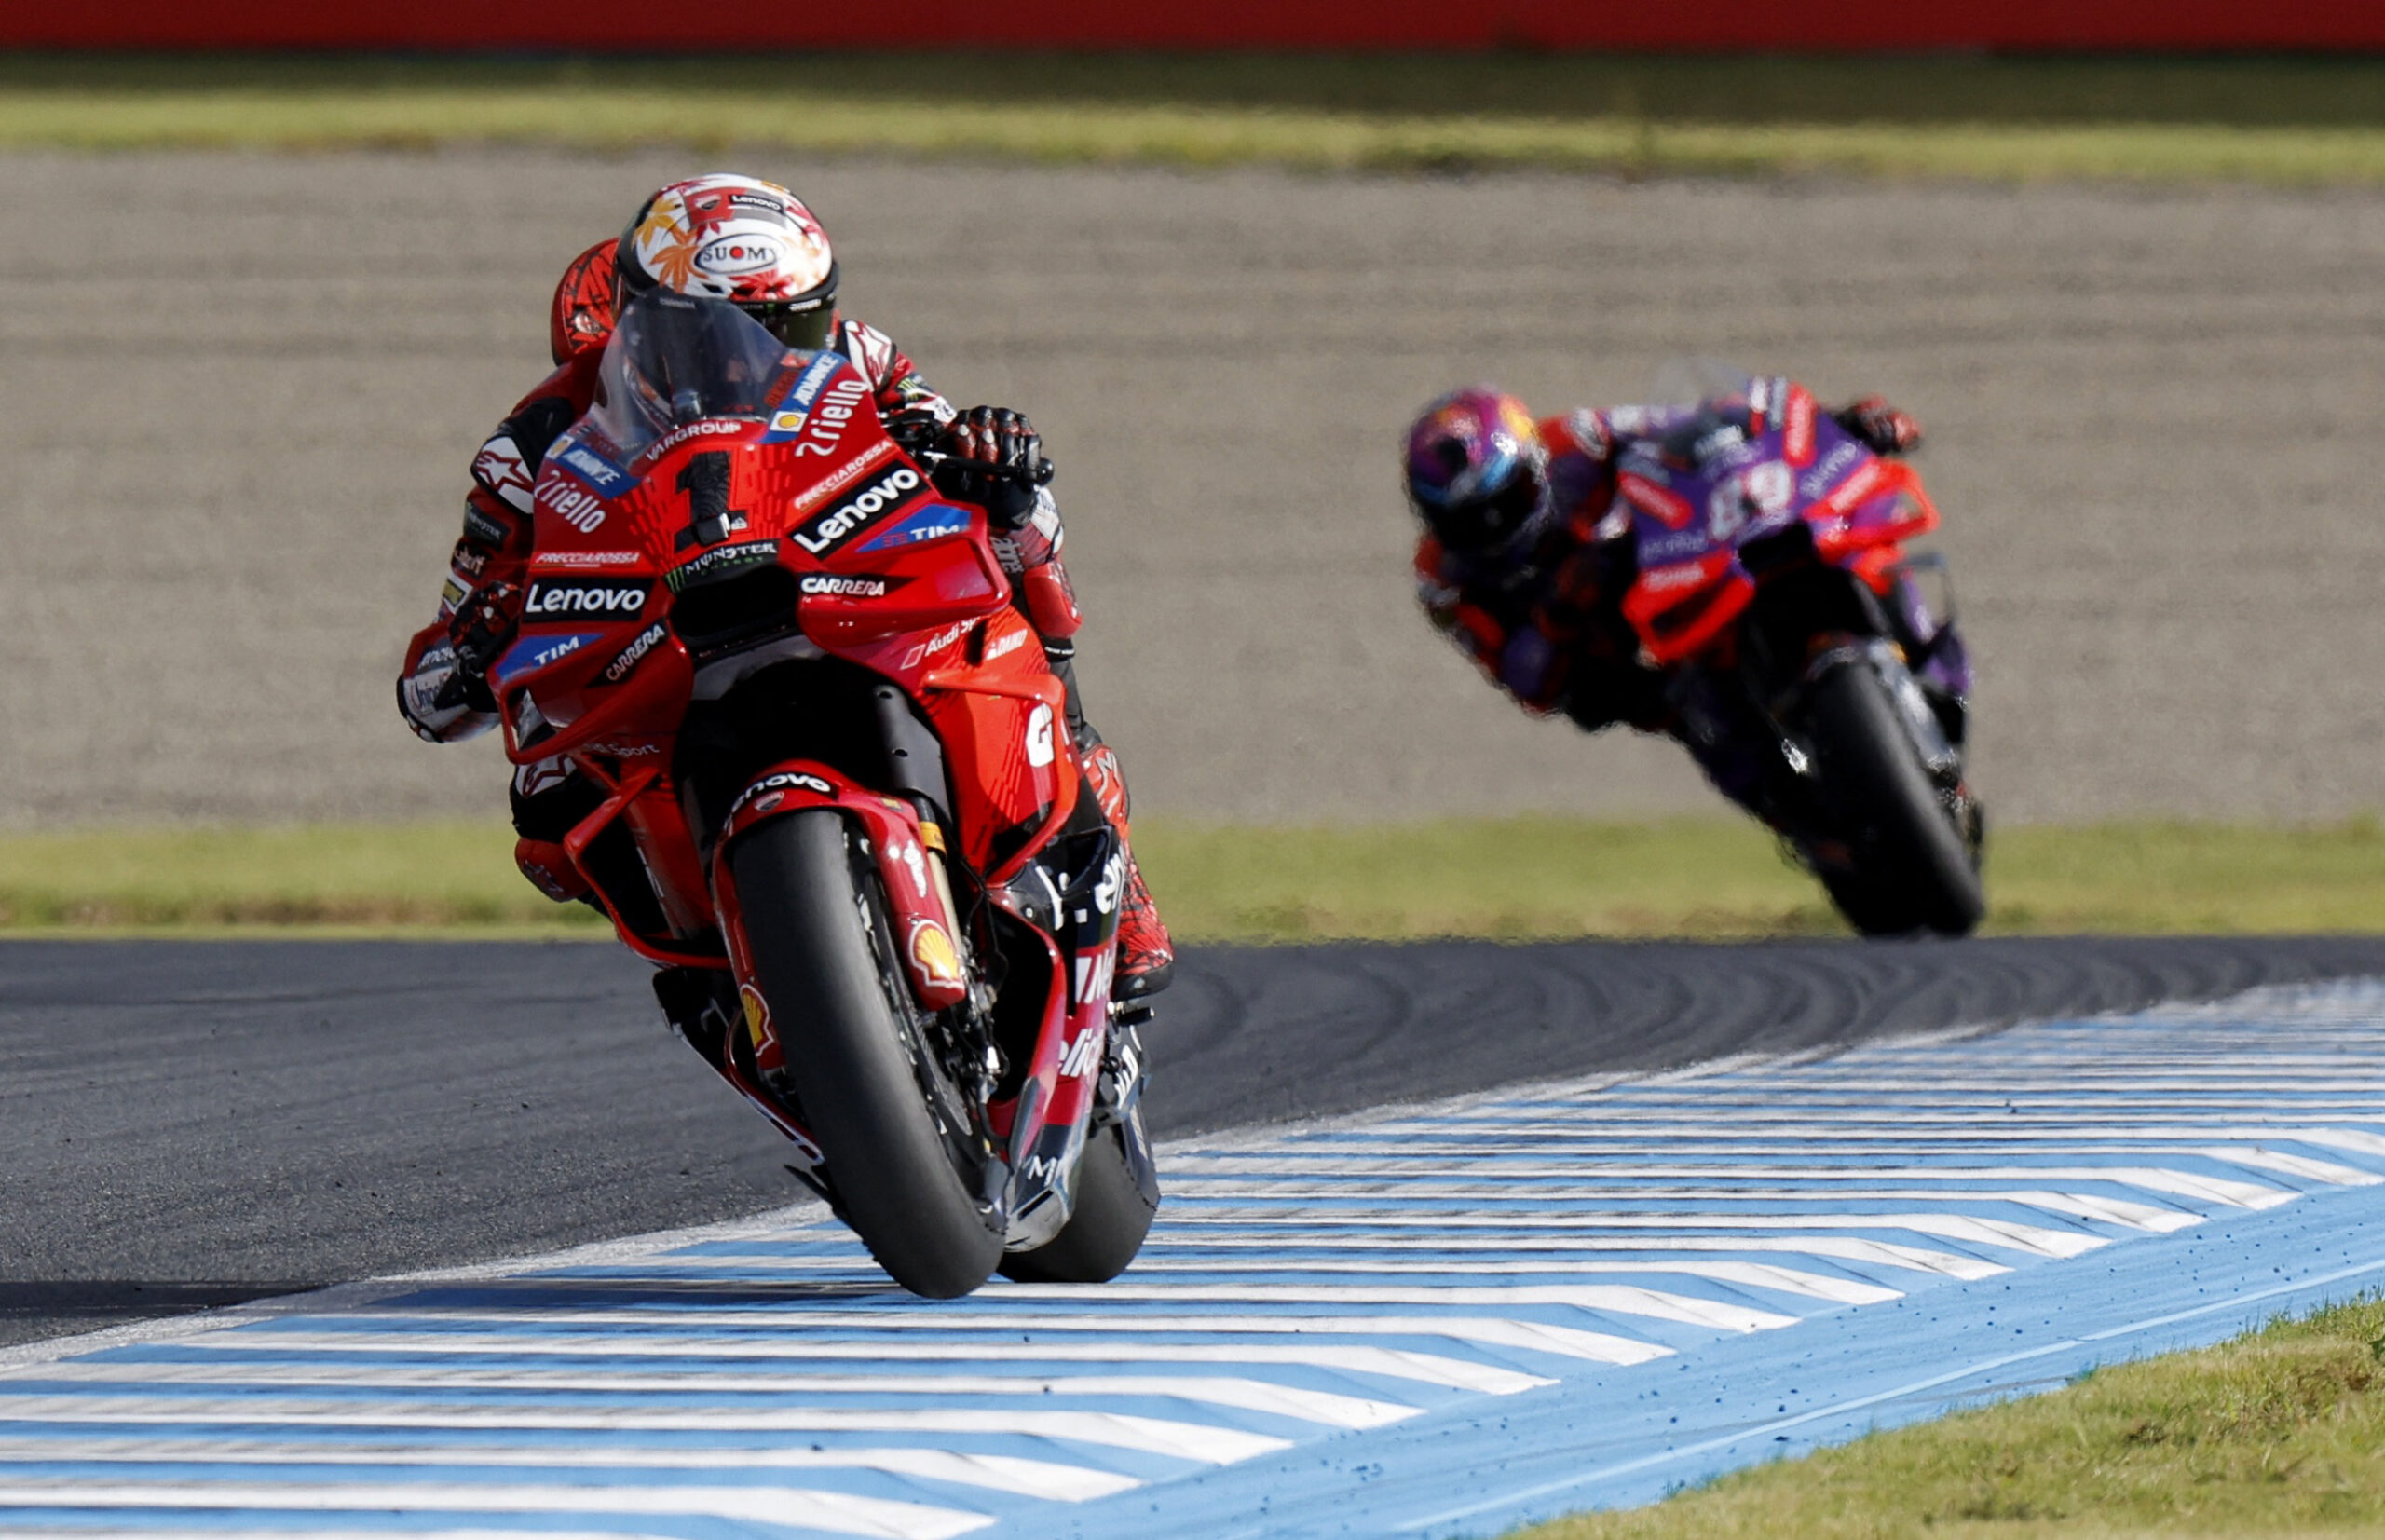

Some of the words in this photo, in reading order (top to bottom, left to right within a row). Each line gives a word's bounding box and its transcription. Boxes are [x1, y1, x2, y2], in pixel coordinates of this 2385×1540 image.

[731, 194, 781, 211] Lenovo
[793, 468, 920, 553] Lenovo
[909, 525, 960, 541] TIM
[685, 542, 779, 575] MONSTER
[525, 583, 646, 613] Lenovo
[801, 576, 885, 596] CARRERA
[534, 635, 580, 665] TIM
[606, 623, 666, 681] CARRERA
[925, 627, 959, 657] Audi
